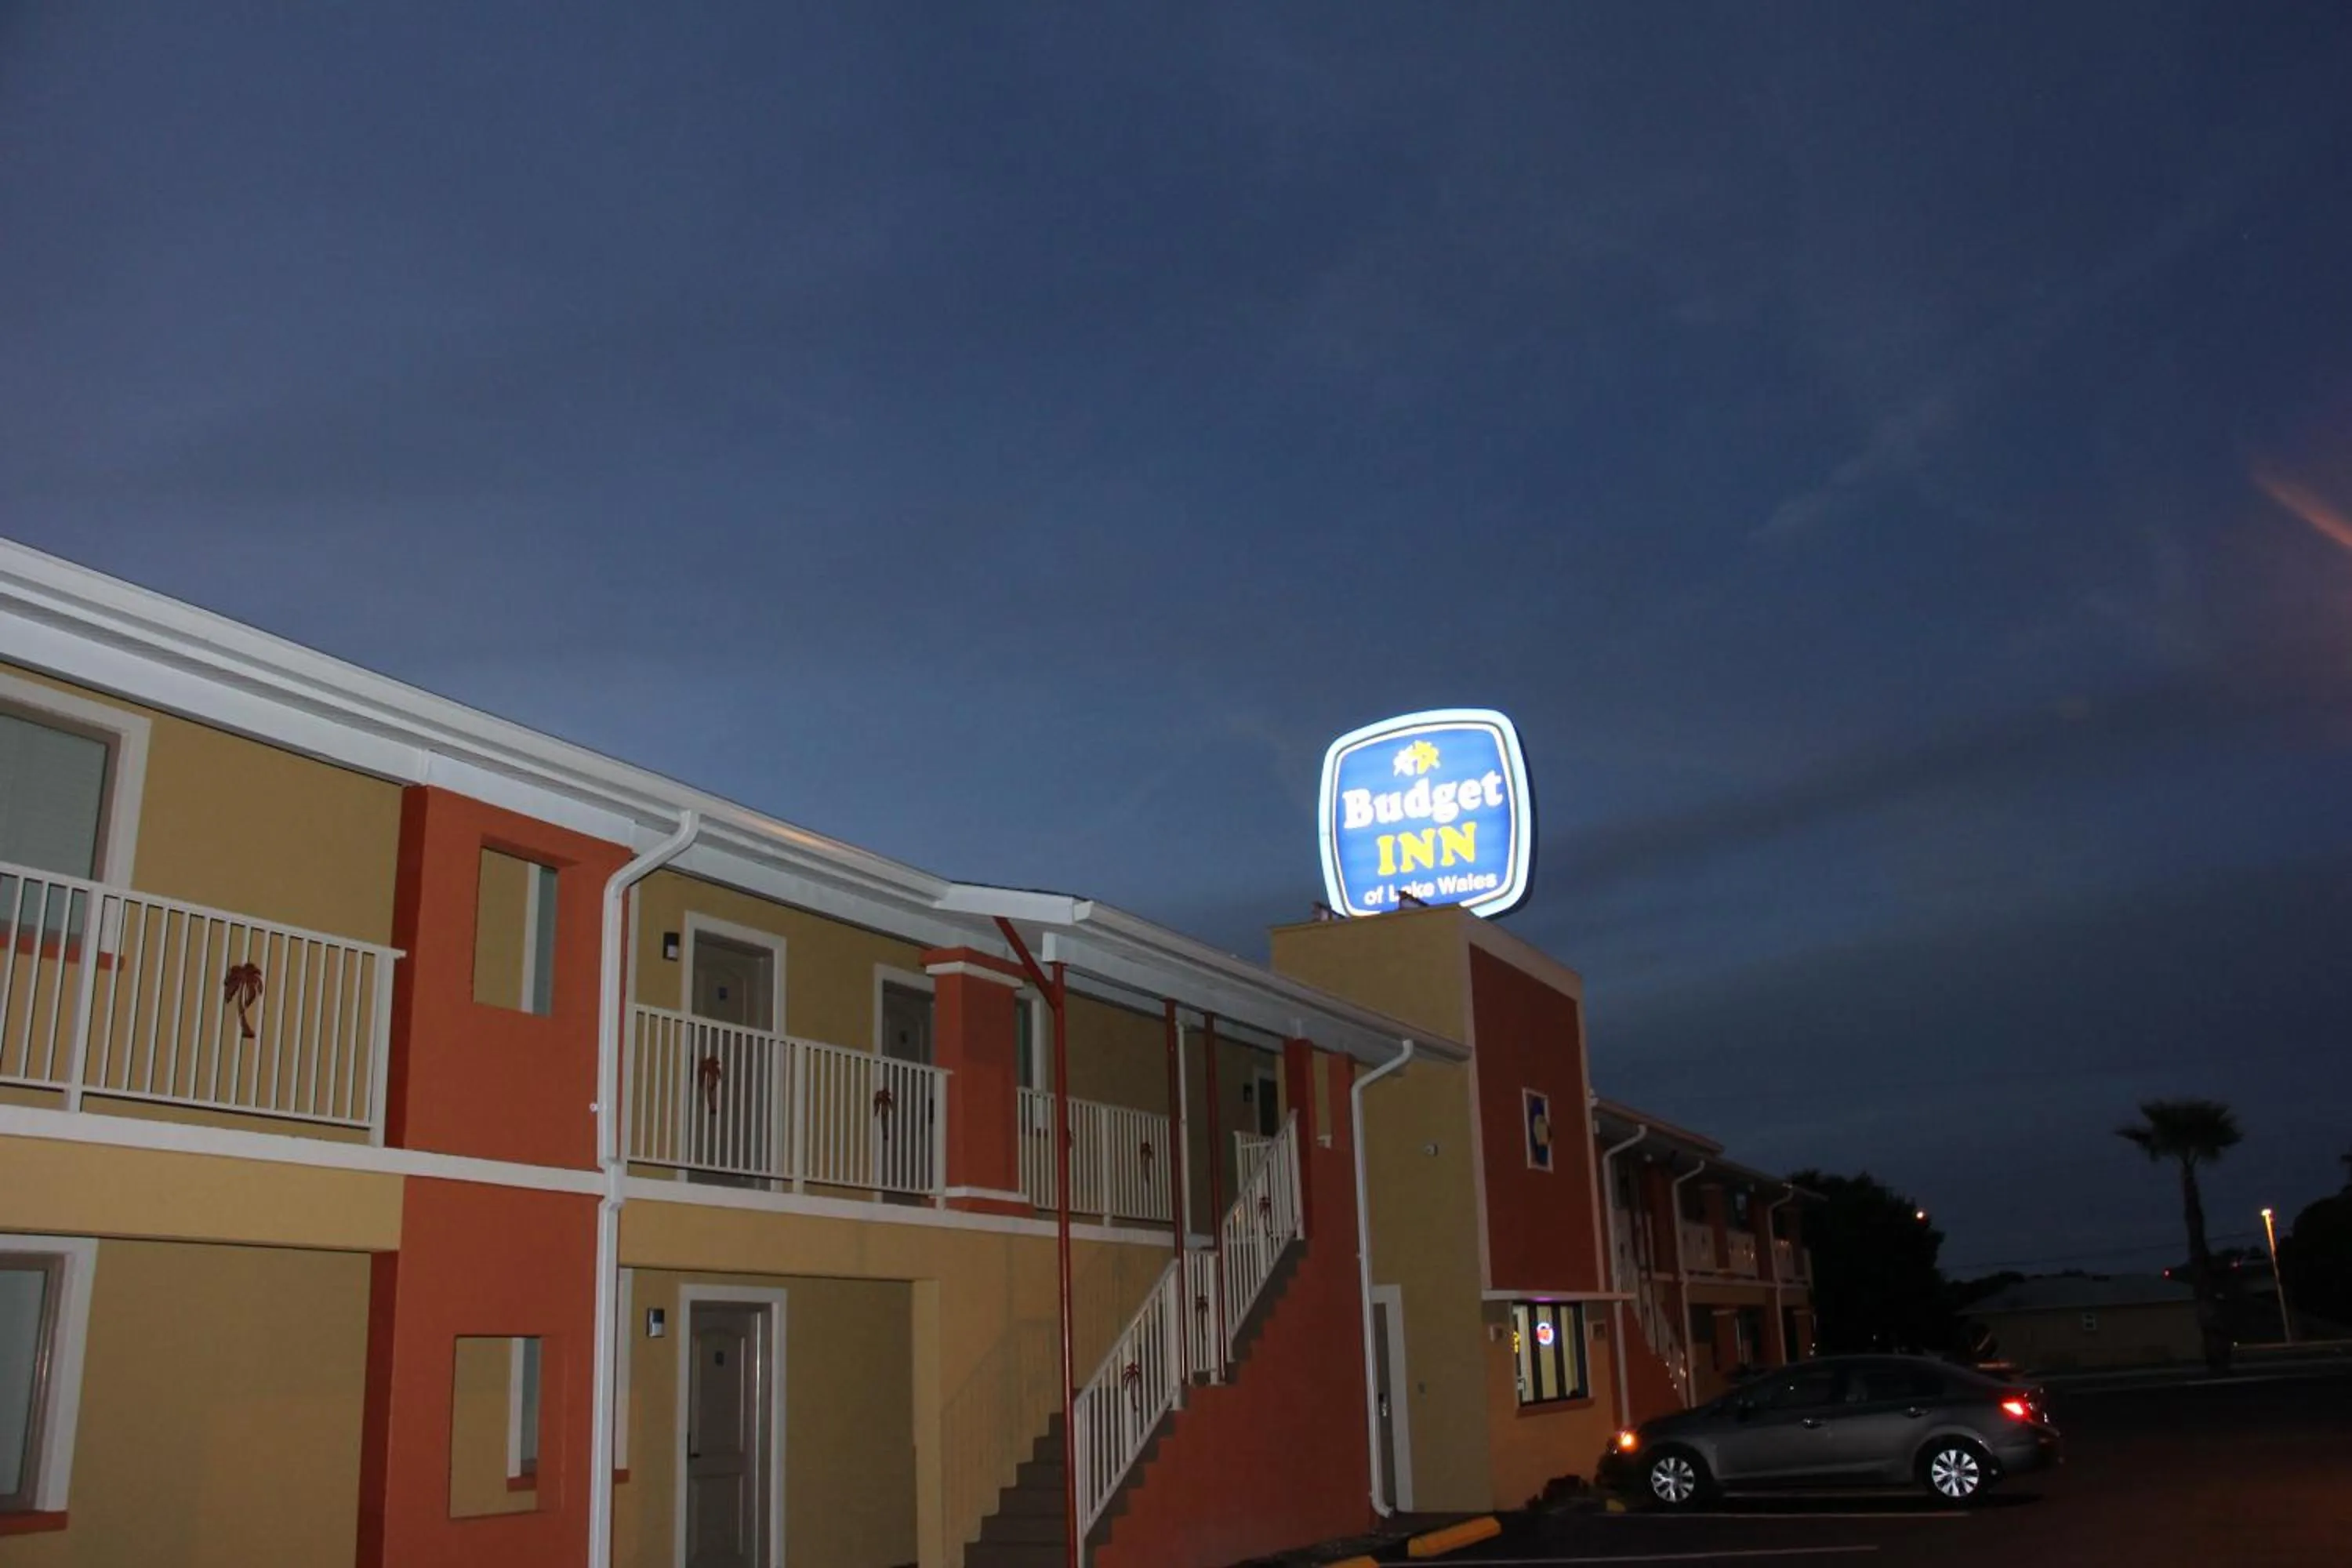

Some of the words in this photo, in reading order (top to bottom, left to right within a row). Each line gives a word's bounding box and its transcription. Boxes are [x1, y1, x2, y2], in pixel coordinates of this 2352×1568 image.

[1342, 771, 1503, 829] Budget
[1377, 822, 1476, 875] INN
[1364, 885, 1384, 905] of
[1437, 873, 1497, 895] Wales
